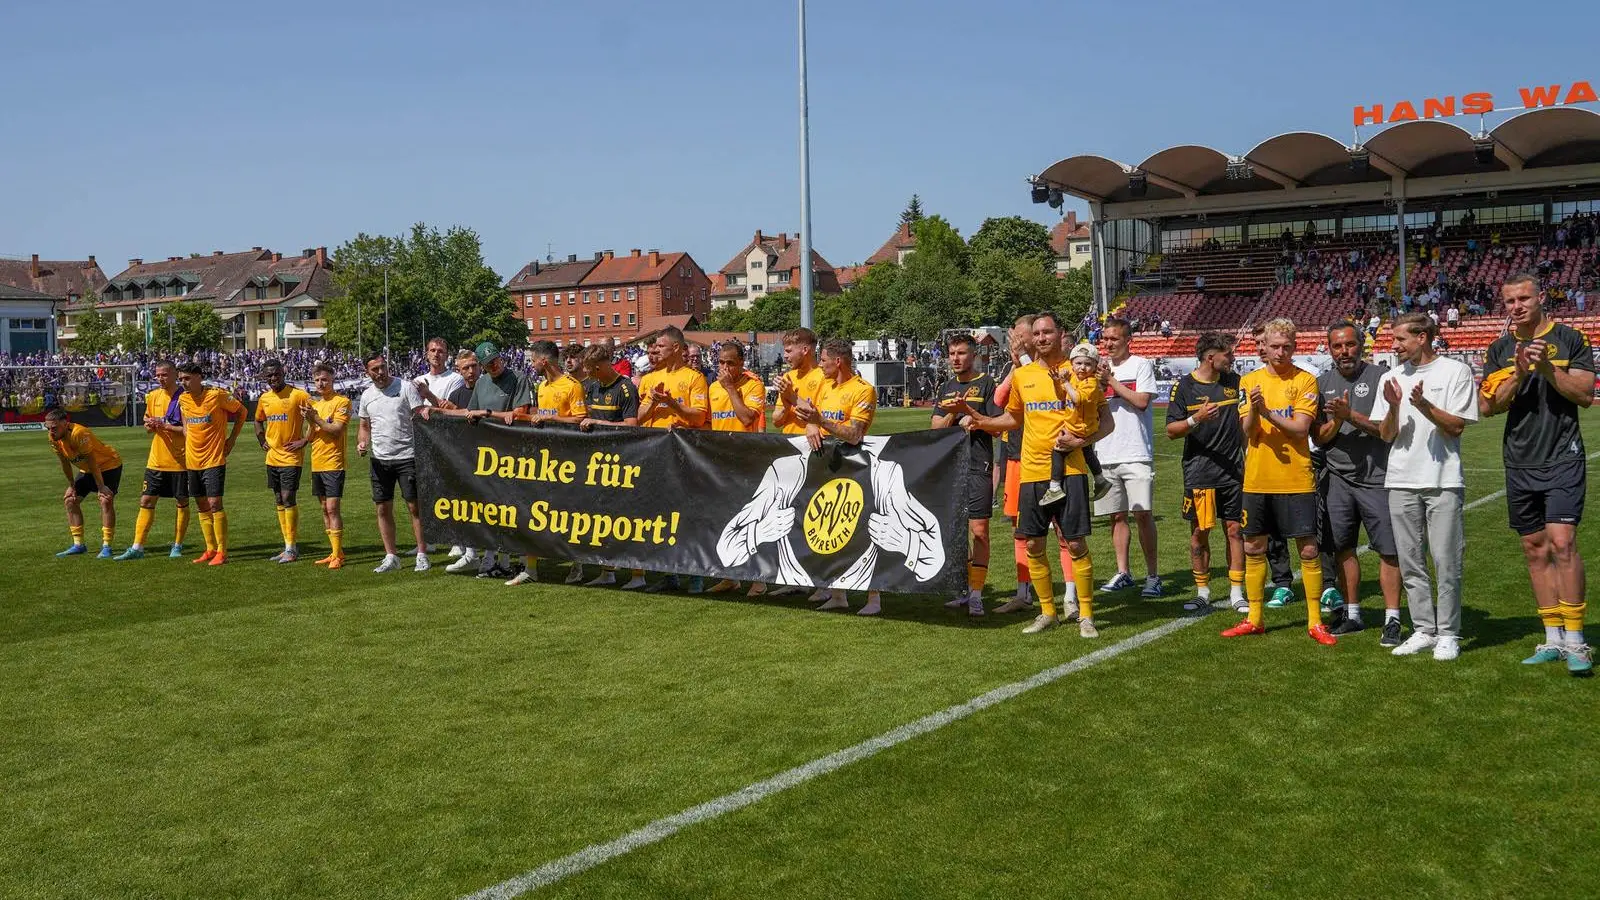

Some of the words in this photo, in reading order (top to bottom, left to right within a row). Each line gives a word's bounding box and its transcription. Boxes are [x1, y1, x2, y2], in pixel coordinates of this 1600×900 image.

[1353, 92, 1494, 126] HANS
[1518, 81, 1598, 109] WA
[712, 410, 737, 420] maxi
[821, 409, 845, 421] axit
[1570, 440, 1578, 454] 4
[475, 446, 576, 483] Danke
[585, 452, 640, 489] für
[434, 496, 517, 529] euren
[529, 501, 680, 547] Support!
[807, 482, 861, 536] SpVgg
[807, 528, 851, 551] BAYREUTH
